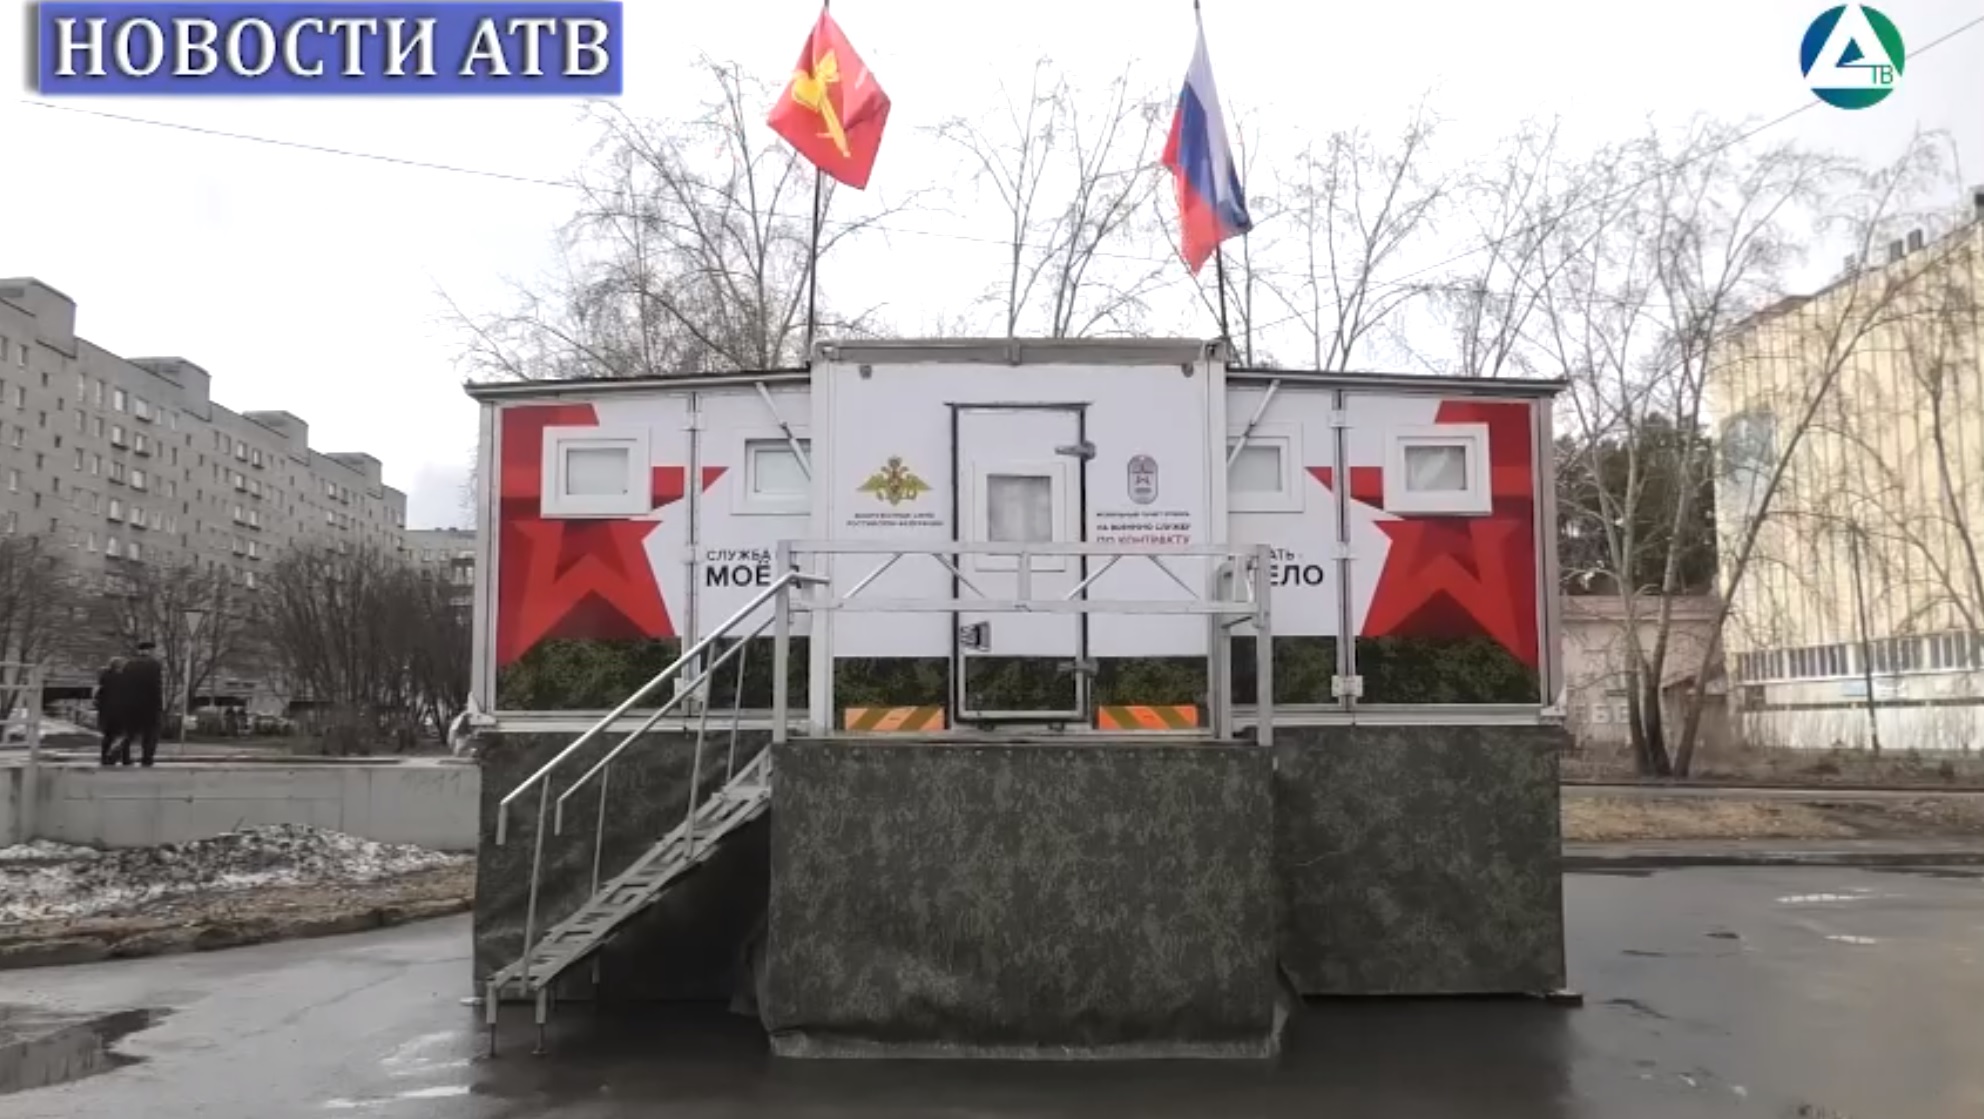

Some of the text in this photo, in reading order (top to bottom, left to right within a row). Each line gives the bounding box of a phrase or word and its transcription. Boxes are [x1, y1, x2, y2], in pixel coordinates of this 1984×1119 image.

[706, 549, 771, 561] СЛУЖБА
[1269, 548, 1295, 561] АТЬ
[706, 560, 771, 588] МОЁ
[1269, 564, 1324, 587] ЕЛО
